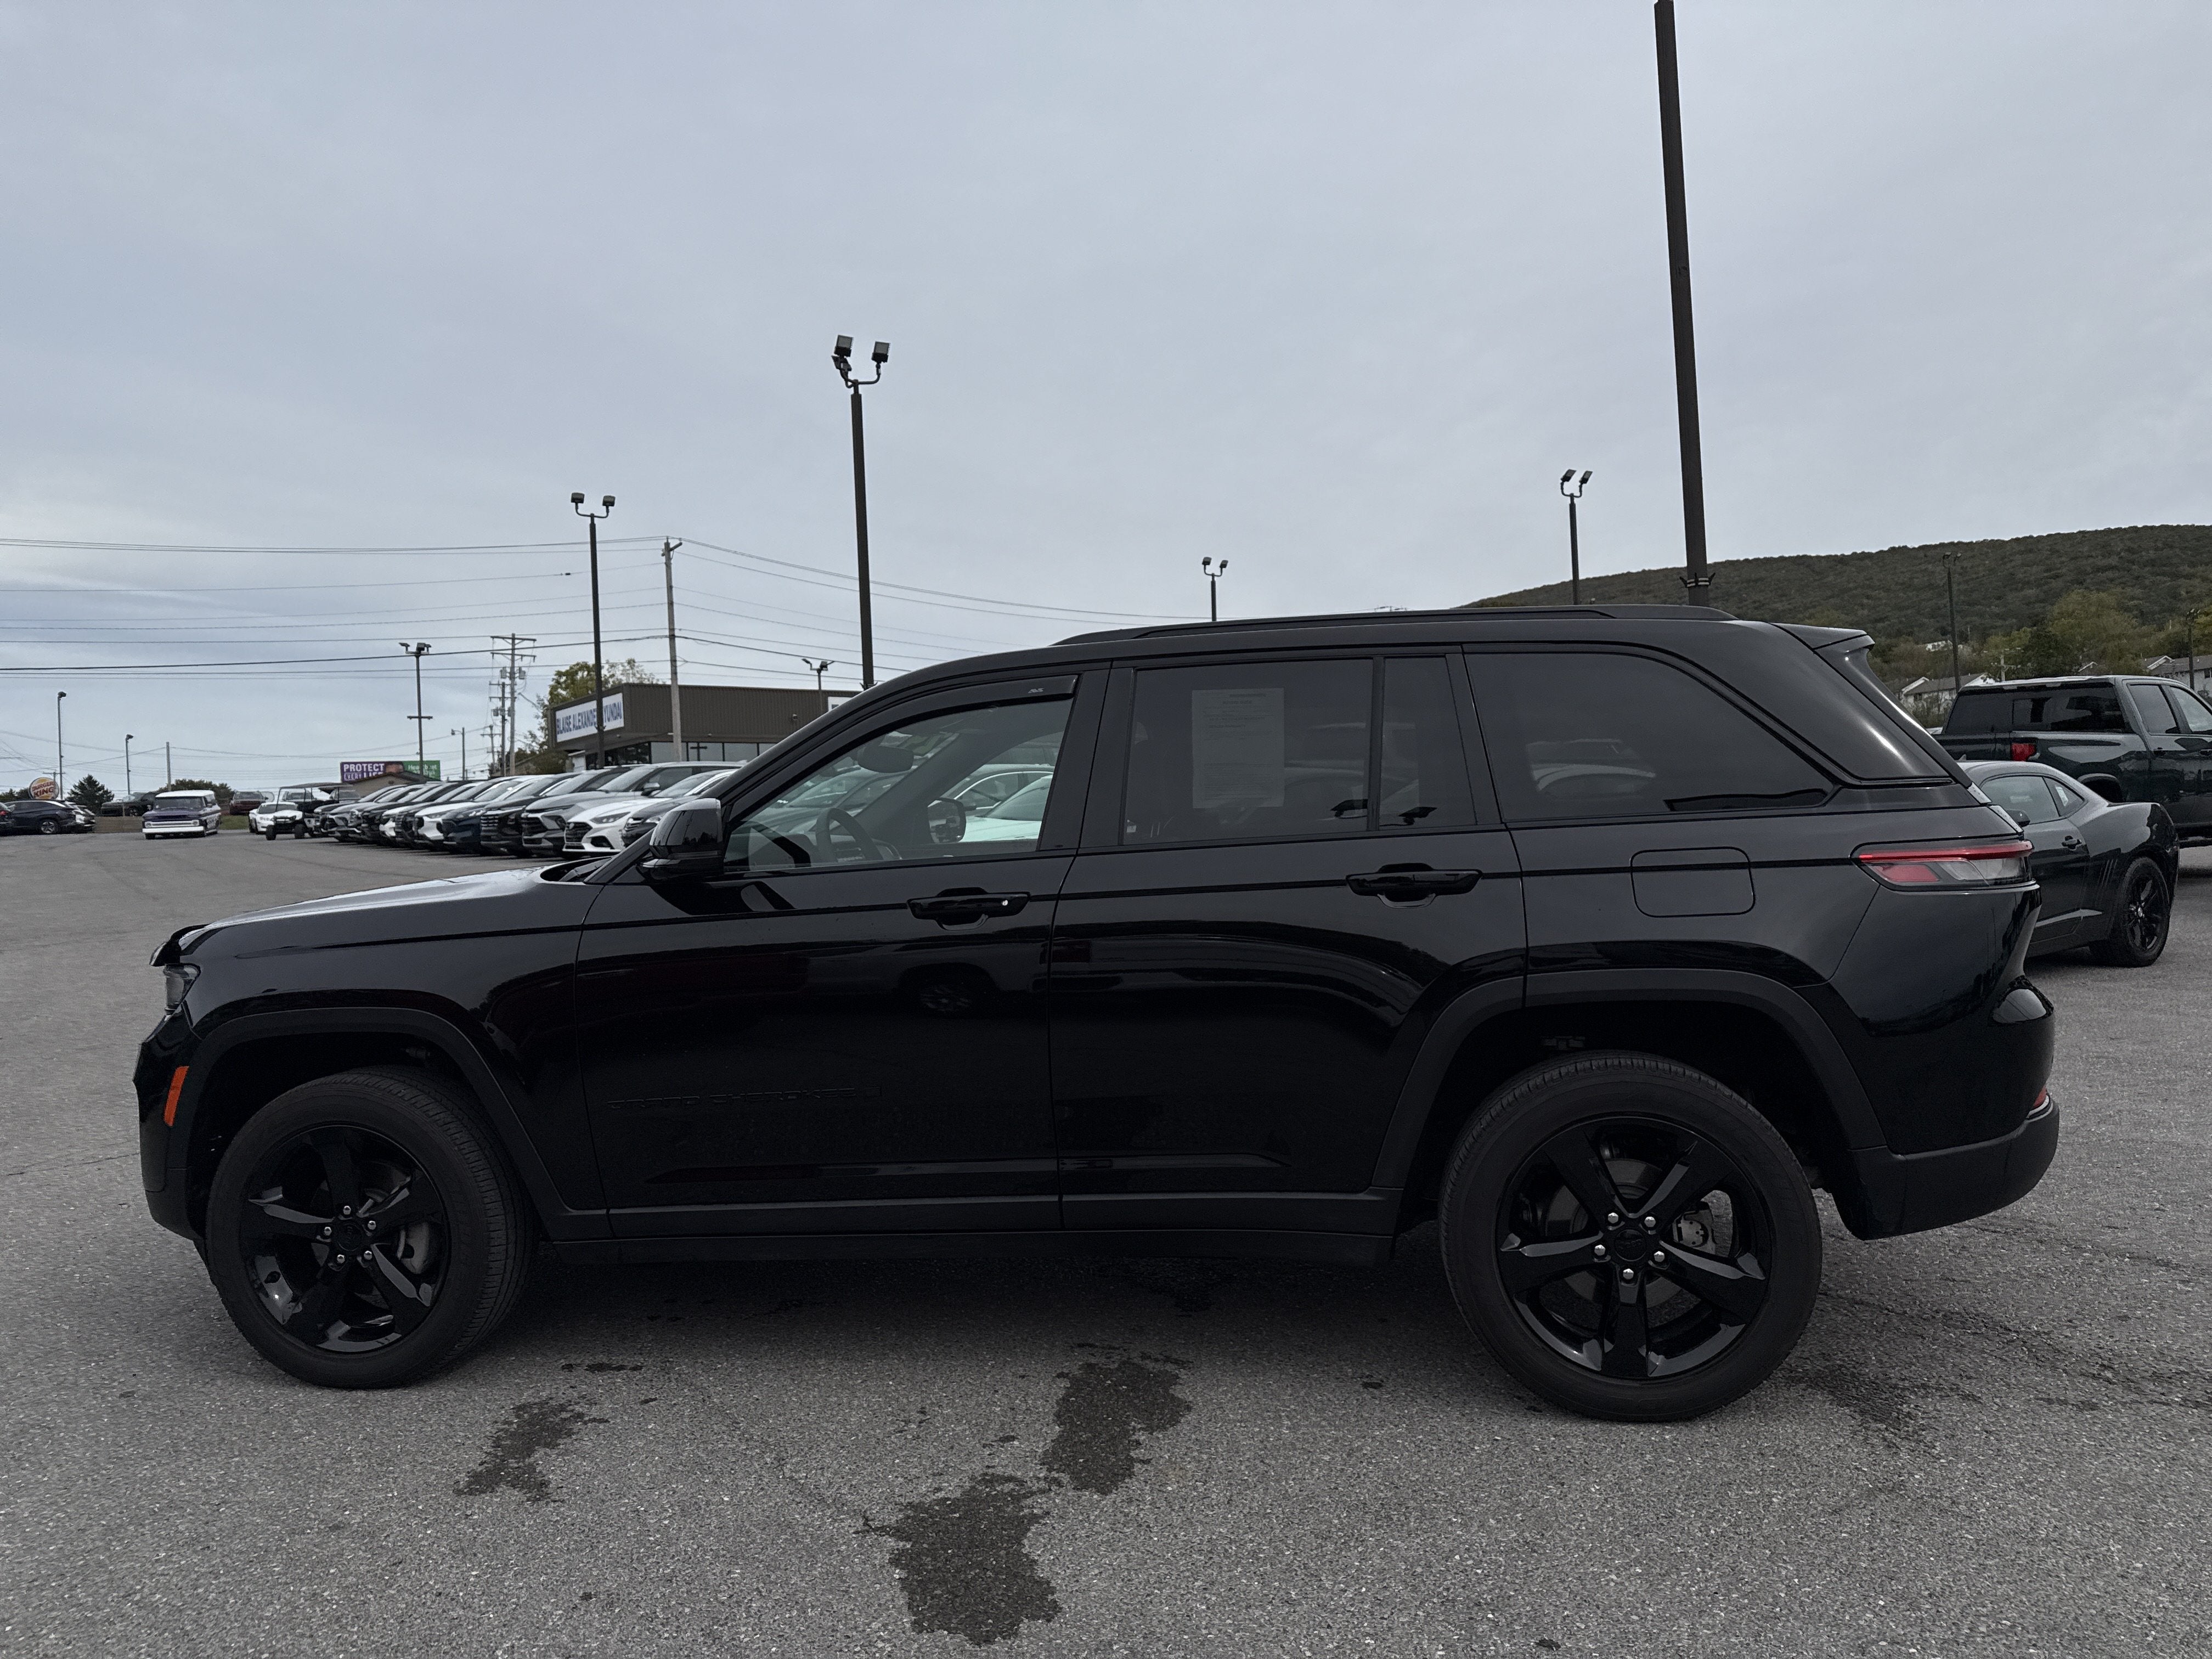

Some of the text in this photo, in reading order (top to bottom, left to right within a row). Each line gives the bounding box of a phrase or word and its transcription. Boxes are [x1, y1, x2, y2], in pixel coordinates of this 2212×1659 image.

[556, 702, 623, 735] BLAISE ALEXANDE YUNDAI
[343, 763, 385, 772] PROTECT
[32, 781, 55, 791] BURGER
[33, 786, 55, 798] KING
